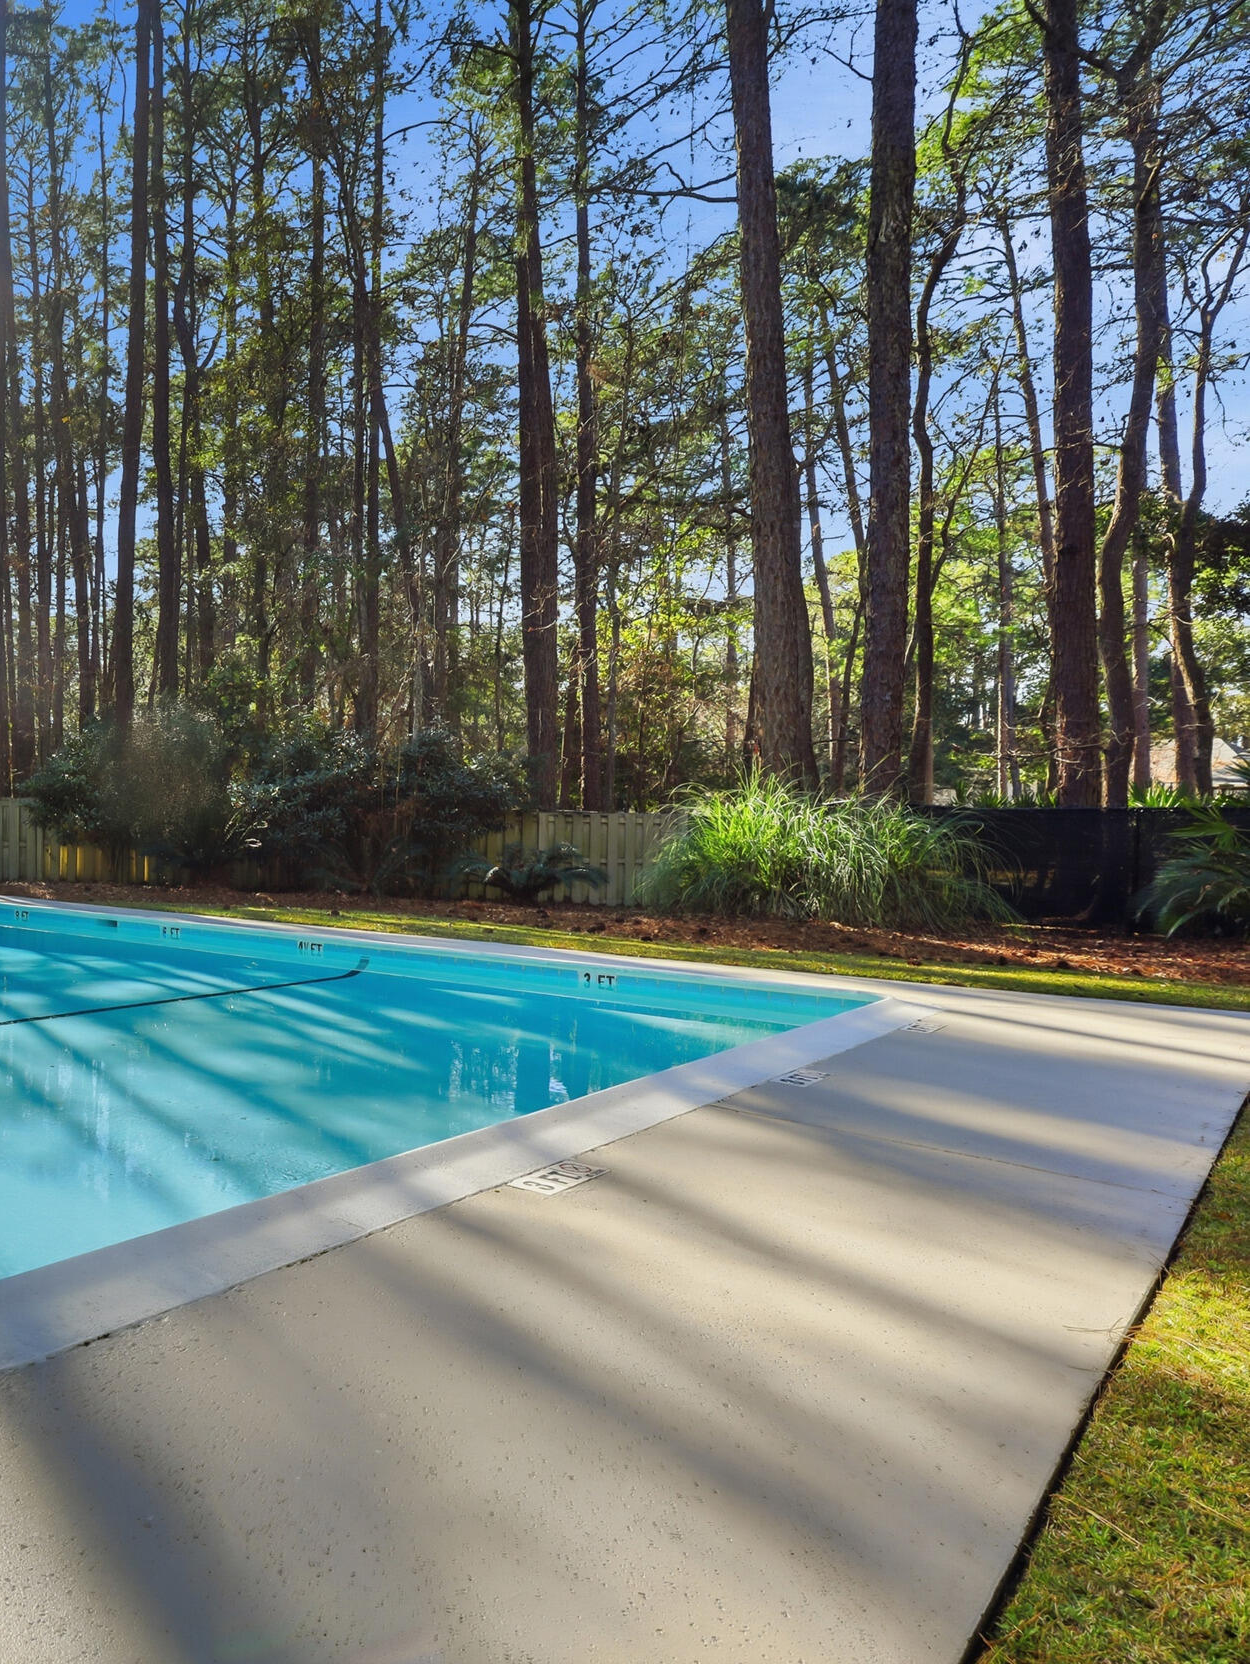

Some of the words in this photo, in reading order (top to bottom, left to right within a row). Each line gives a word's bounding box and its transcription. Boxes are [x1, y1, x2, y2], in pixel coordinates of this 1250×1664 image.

[597, 974, 615, 985] FT
[538, 1170, 583, 1185] FT
[522, 1180, 555, 1191] 3
